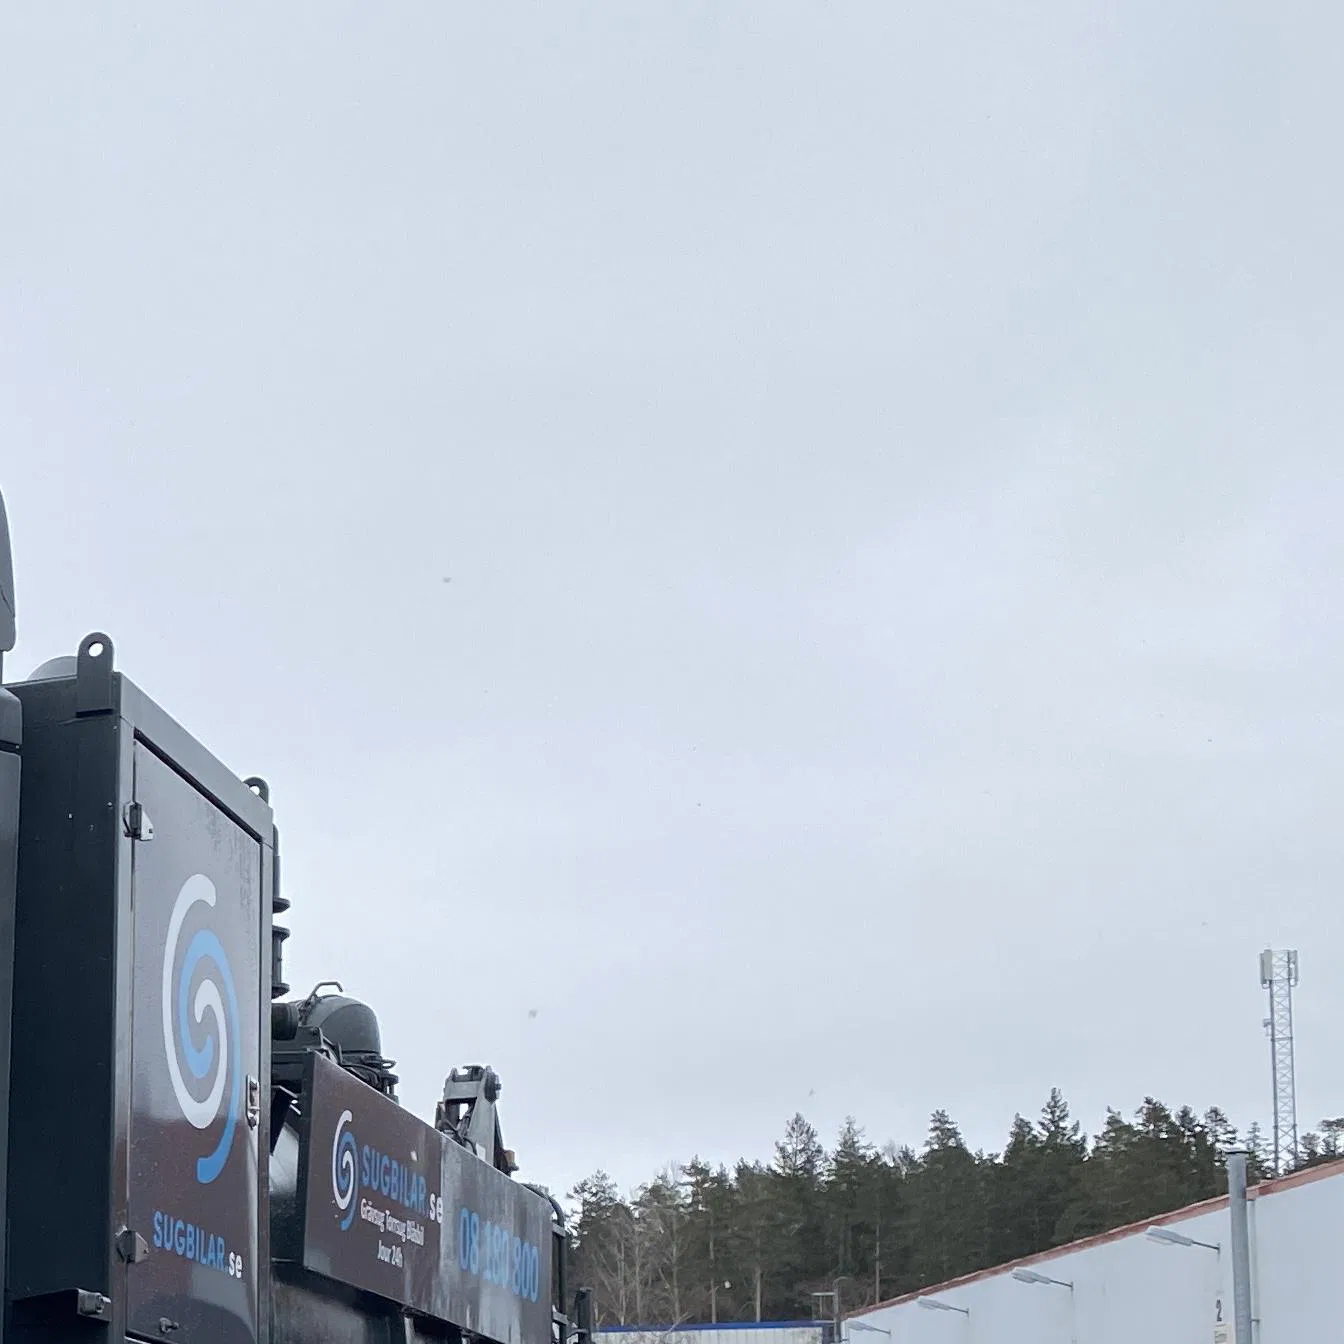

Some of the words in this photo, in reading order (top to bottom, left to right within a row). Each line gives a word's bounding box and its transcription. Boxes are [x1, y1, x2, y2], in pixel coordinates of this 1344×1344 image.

[362, 1144, 443, 1224] SUGBILAR.se
[153, 1210, 243, 1279] SUGBILAR.se
[459, 1207, 480, 1275] 08
[511, 1236, 539, 1303] 800
